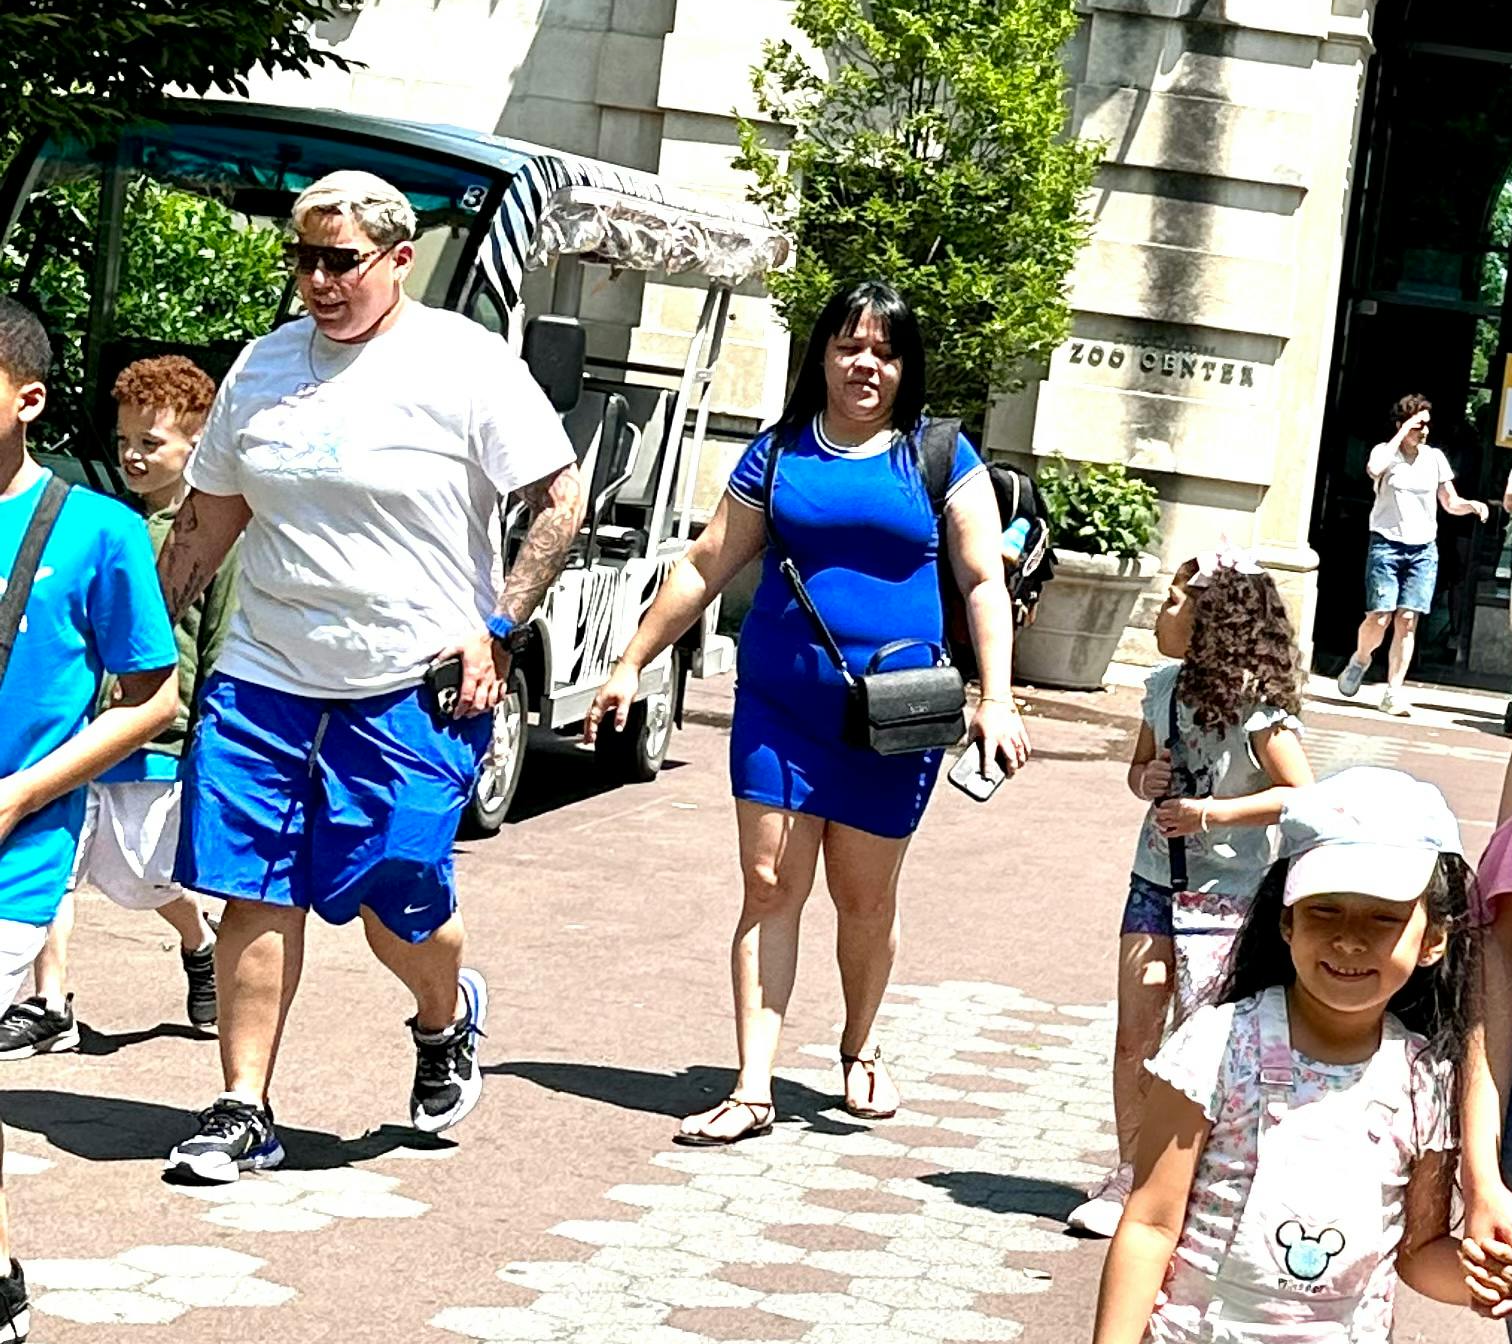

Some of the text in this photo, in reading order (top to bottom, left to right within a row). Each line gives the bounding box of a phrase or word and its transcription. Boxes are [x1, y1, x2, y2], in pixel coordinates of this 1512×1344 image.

[463, 187, 485, 208] 3
[1069, 343, 1125, 369] ZOO
[1140, 353, 1254, 388] CENTER
